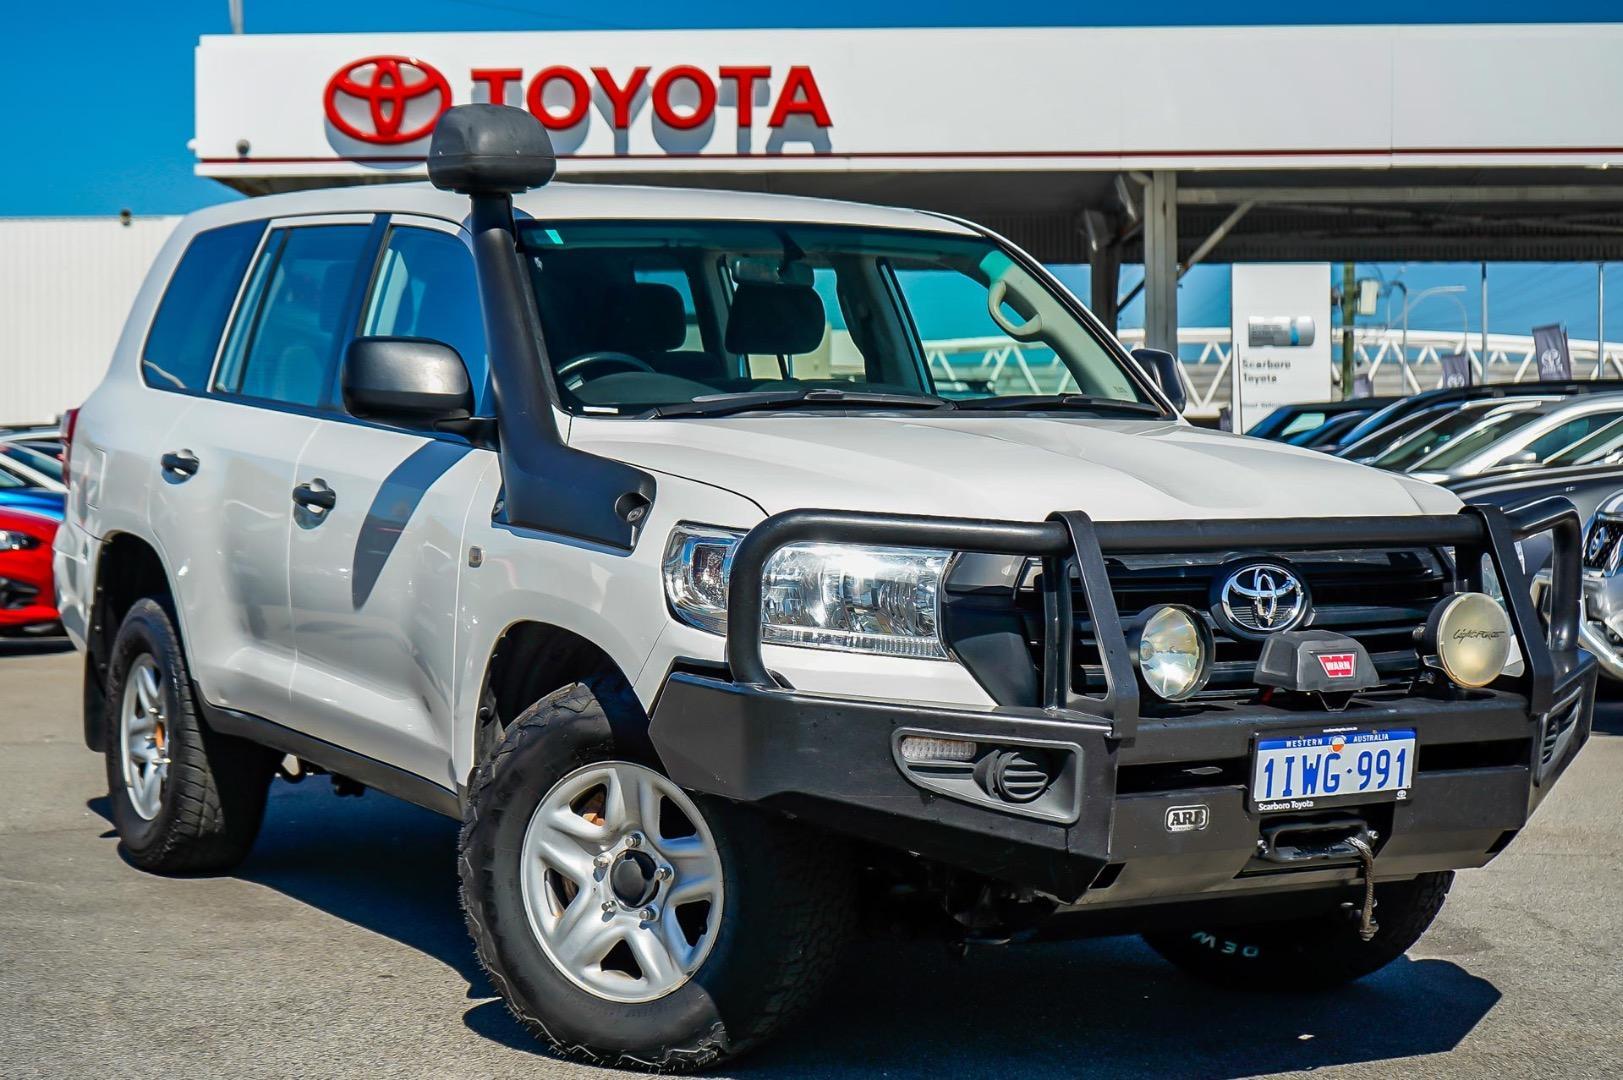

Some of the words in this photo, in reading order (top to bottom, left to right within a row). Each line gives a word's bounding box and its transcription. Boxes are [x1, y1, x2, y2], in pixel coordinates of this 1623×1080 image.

[470, 65, 833, 129] TOYOTA
[1242, 359, 1291, 369] Scarboro
[1243, 373, 1278, 385] Toyota
[1325, 661, 1351, 670] WARN
[1286, 738, 1323, 748] WESTERN
[1353, 733, 1389, 743] AUSTRALIA
[1258, 802, 1290, 811] Scarboro
[1291, 800, 1314, 810] Toyota
[1170, 811, 1204, 826] ARB
